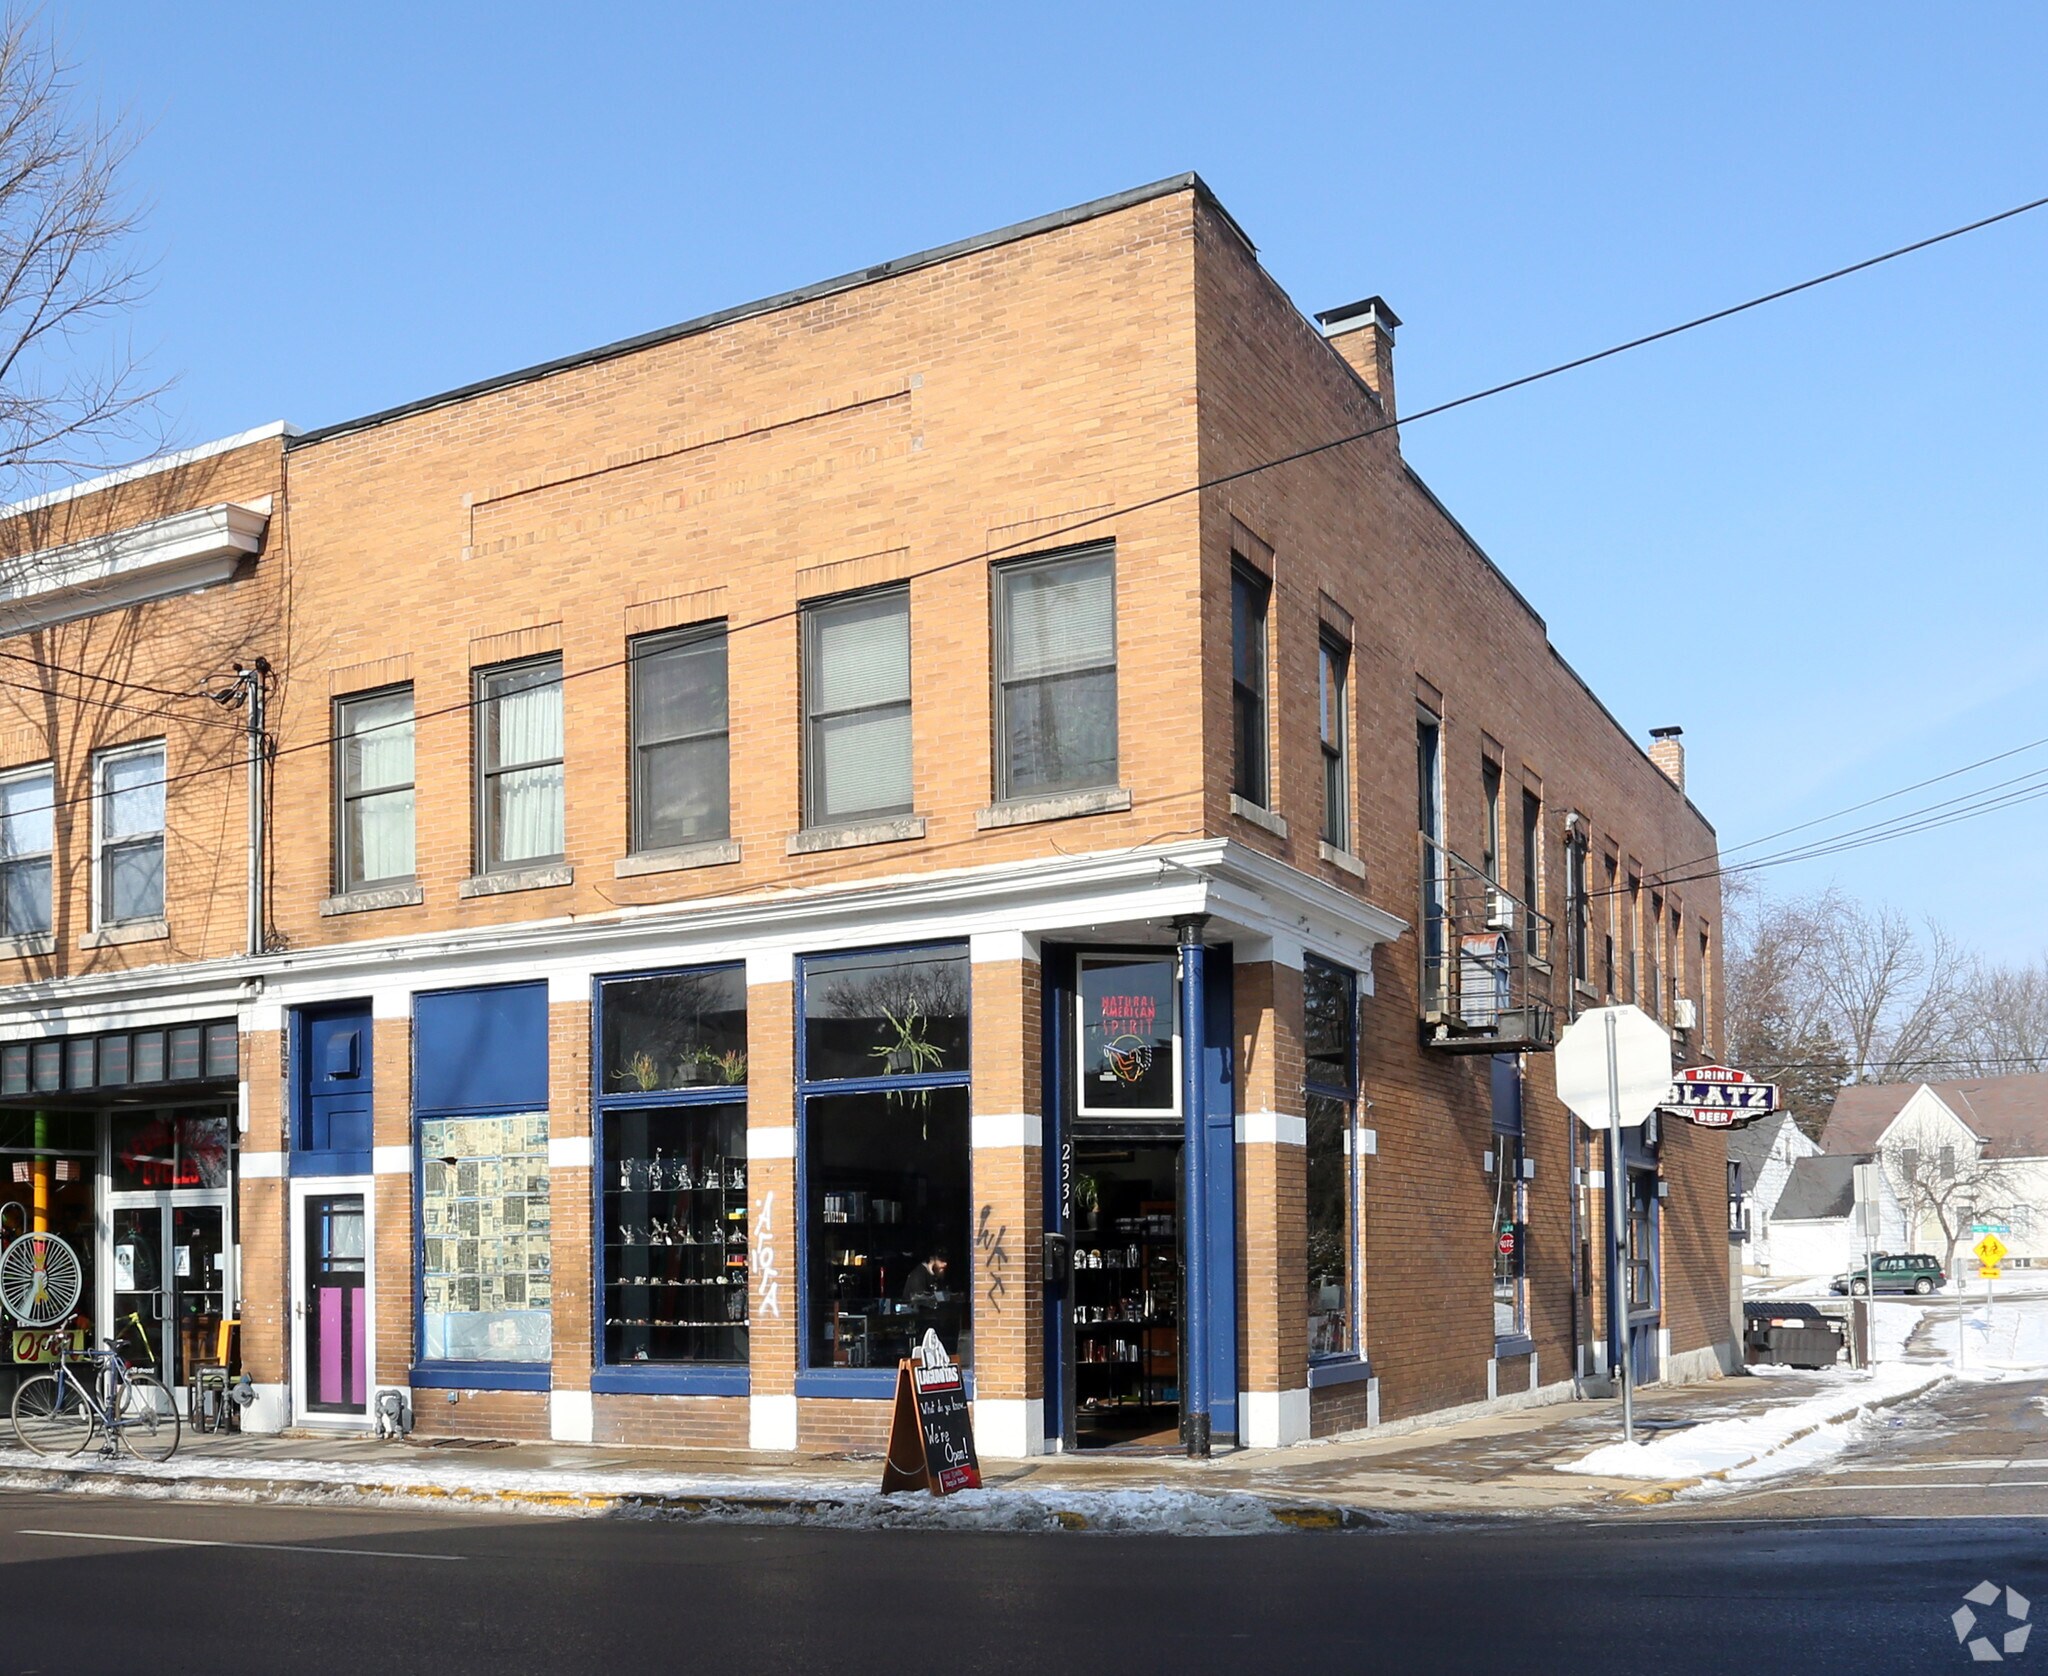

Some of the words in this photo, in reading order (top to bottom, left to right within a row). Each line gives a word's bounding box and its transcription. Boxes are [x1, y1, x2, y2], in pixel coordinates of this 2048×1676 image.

[1102, 996, 1155, 1007] NATURAL
[1102, 1006, 1156, 1018] AMERICAN
[1103, 1019, 1153, 1035] SPIRIT
[1696, 1070, 1733, 1081] DRINK
[1660, 1085, 1767, 1107] BLATZ
[1698, 1111, 1728, 1121] BEER
[1061, 1143, 1071, 1219] 2334
[924, 1423, 950, 1446] We're
[944, 1437, 969, 1468] Open!
